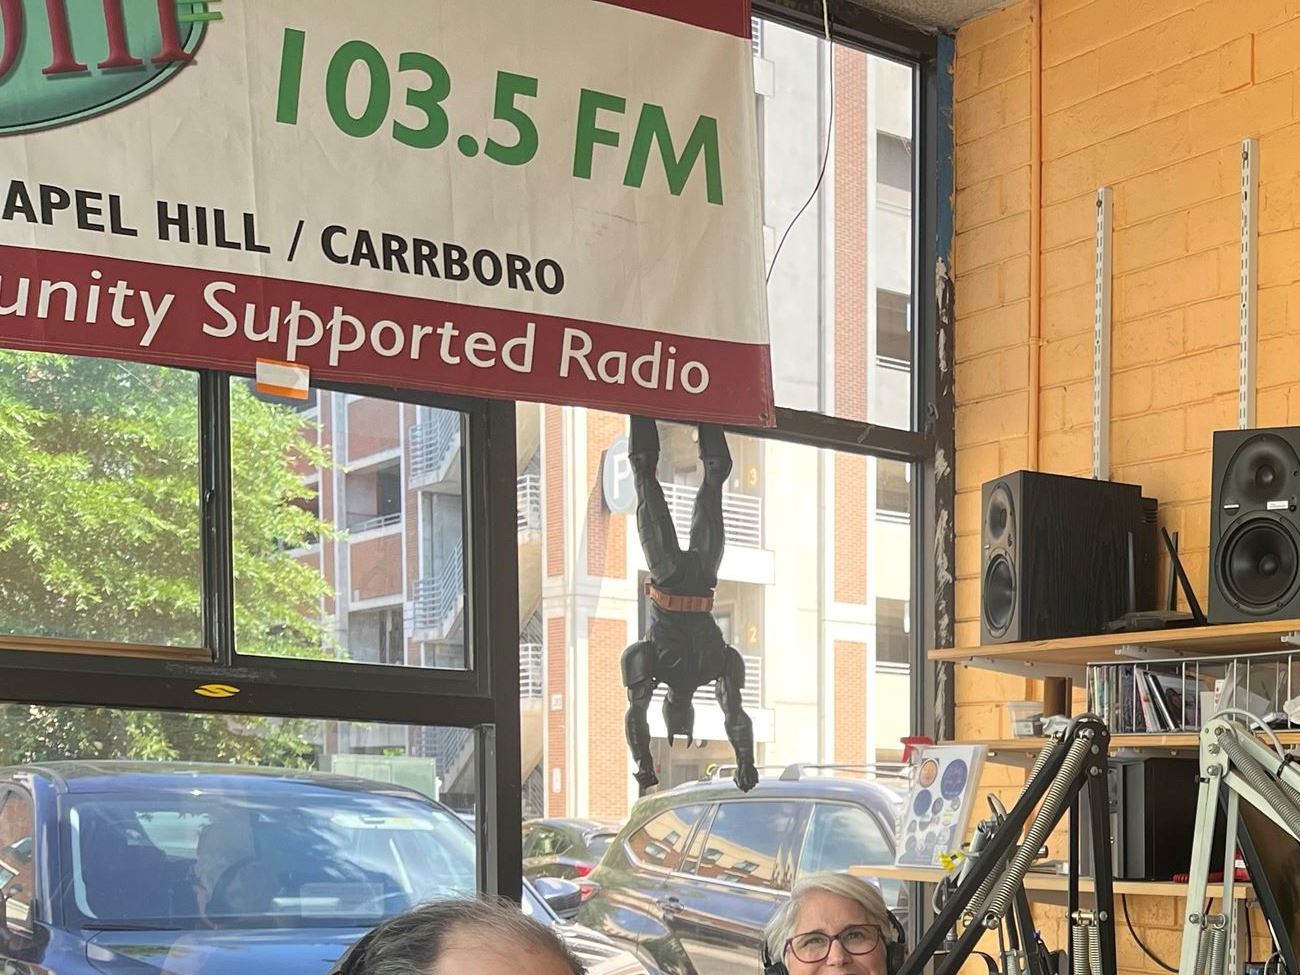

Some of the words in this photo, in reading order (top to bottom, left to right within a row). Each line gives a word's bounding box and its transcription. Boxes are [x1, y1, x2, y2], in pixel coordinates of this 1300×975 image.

[276, 27, 539, 166] 103.5
[573, 87, 725, 206] FM
[2, 180, 138, 238] APEL
[156, 201, 272, 254] HILL
[287, 220, 305, 263] /
[320, 225, 566, 295] CARRBORO
[0, 269, 175, 347] unity
[202, 281, 537, 374] Supported
[560, 334, 711, 395] Radio
[613, 452, 632, 499] P
[749, 467, 757, 485] 3
